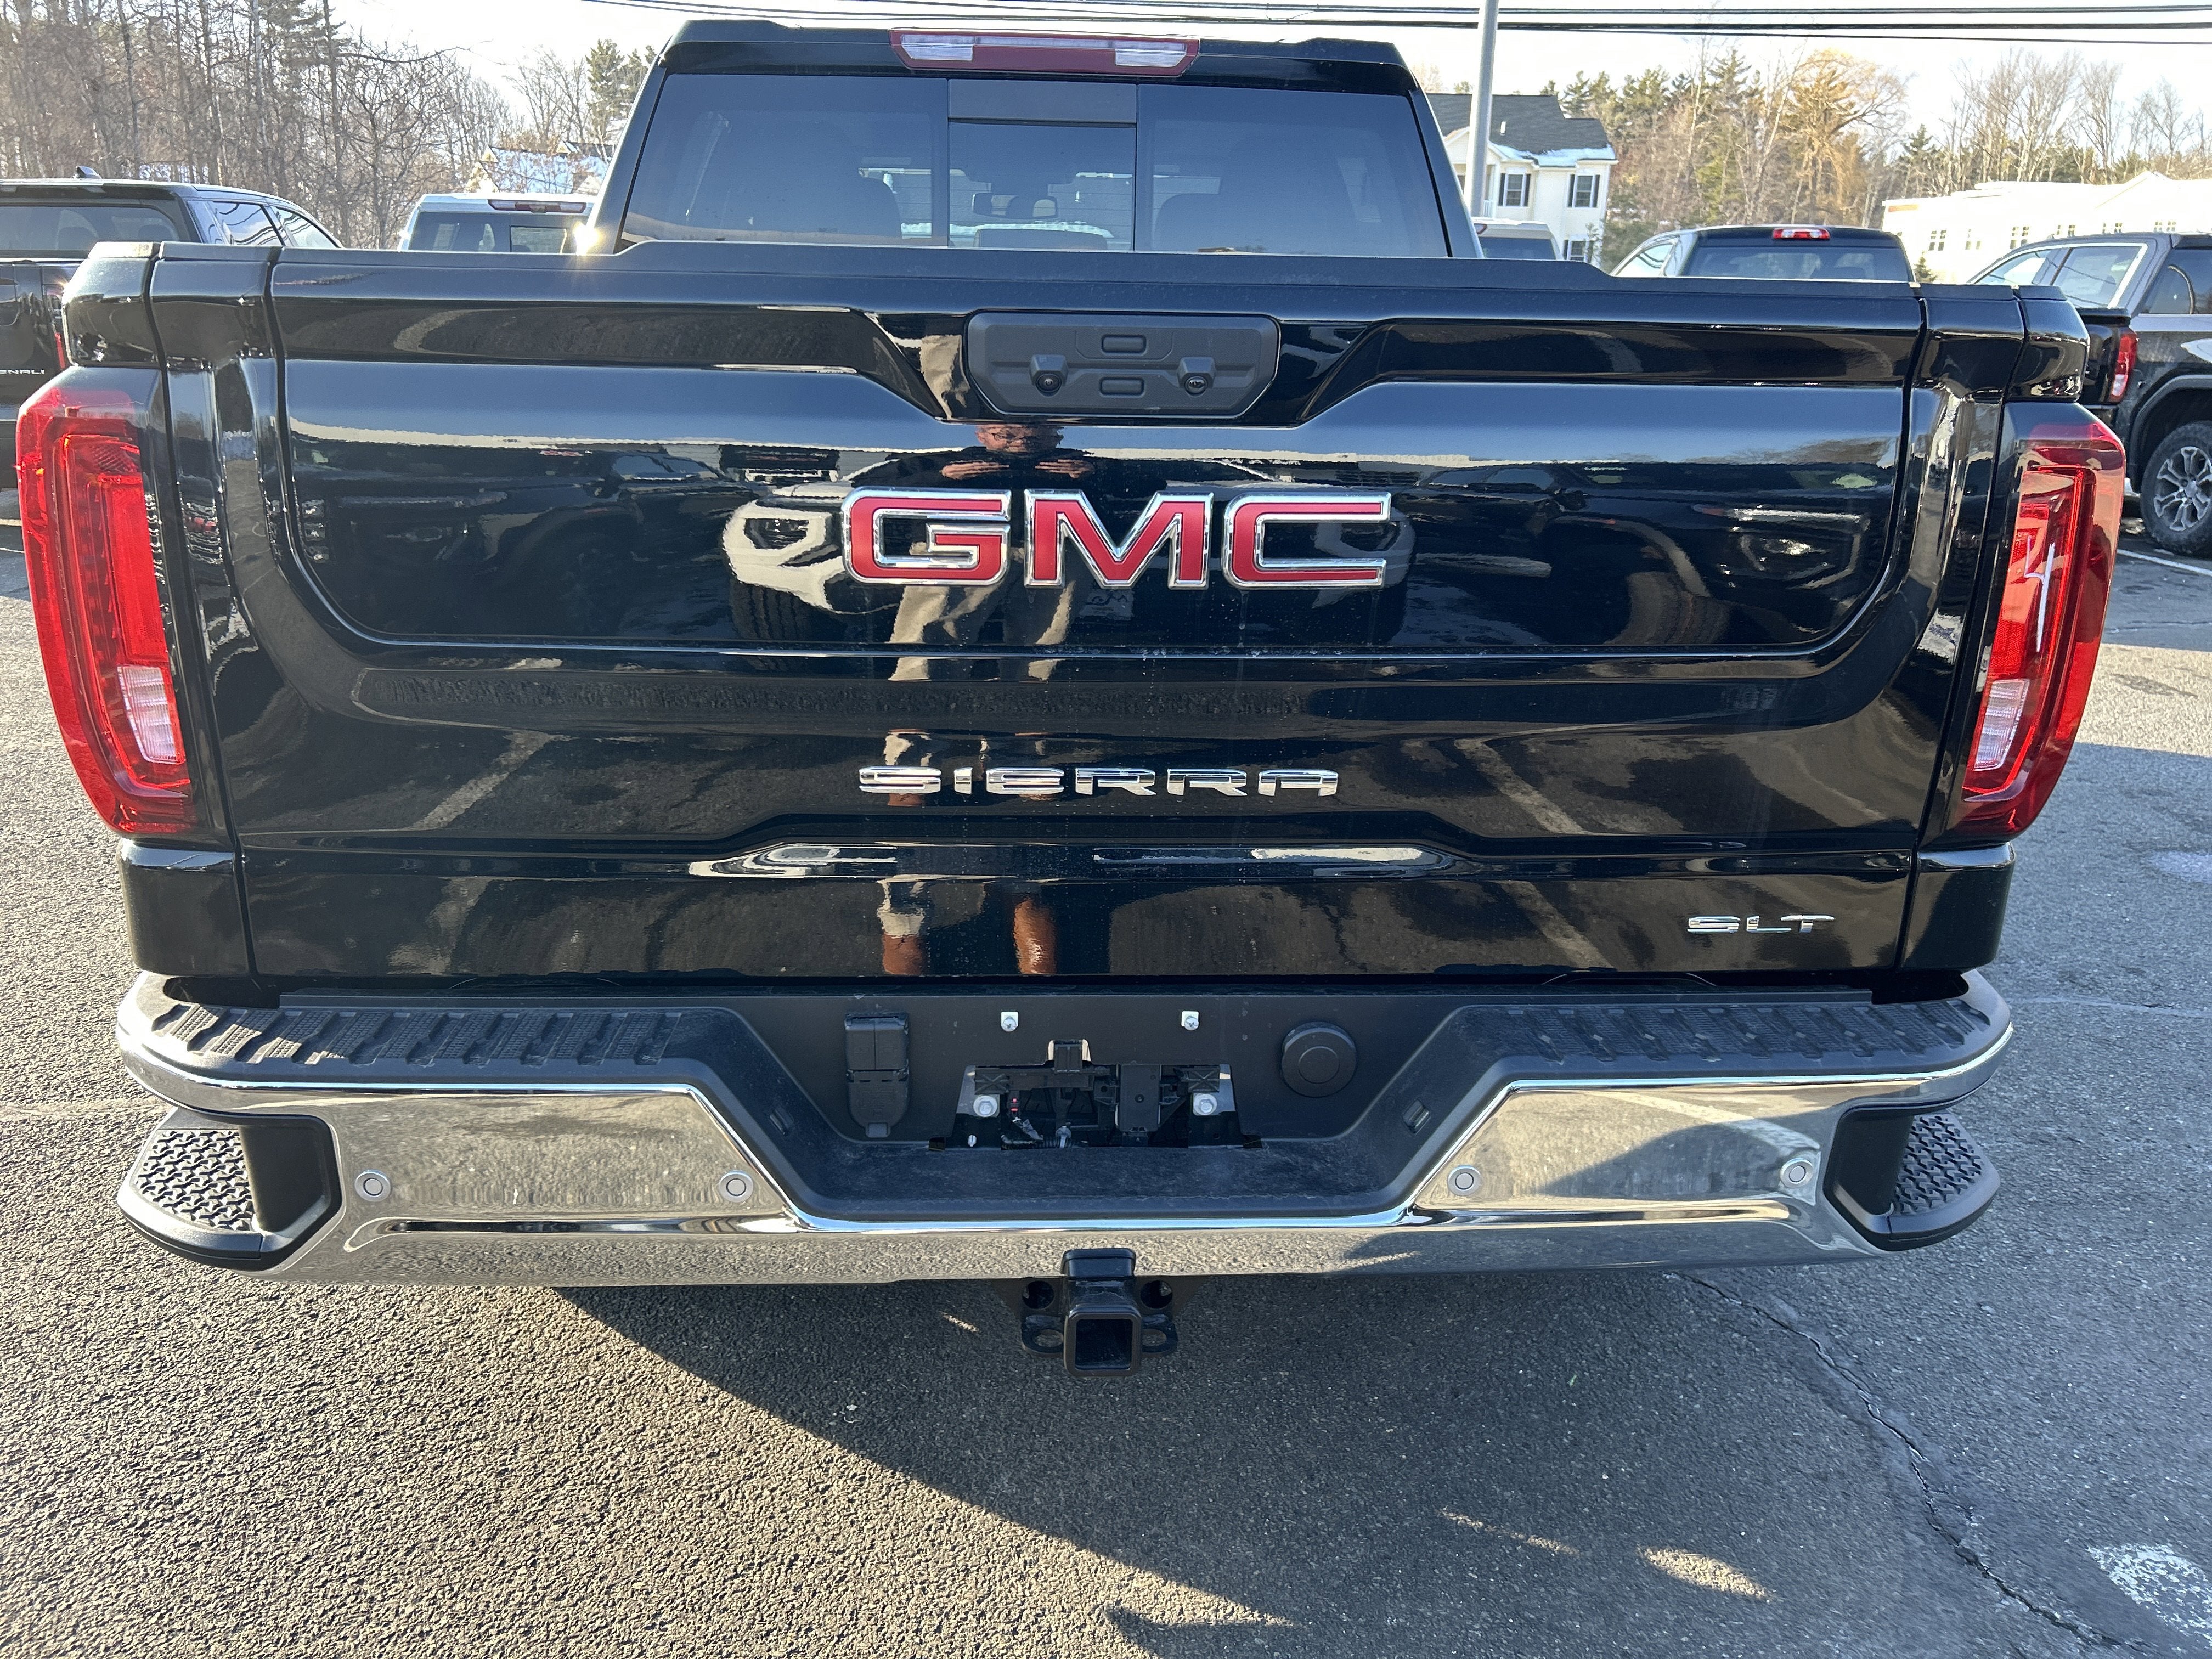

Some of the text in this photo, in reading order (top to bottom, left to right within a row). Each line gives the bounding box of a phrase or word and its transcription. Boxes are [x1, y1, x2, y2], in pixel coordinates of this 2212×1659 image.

[841, 486, 1391, 589] GMC
[859, 766, 1338, 797] SIERRA
[1687, 915, 1835, 933] SLT
